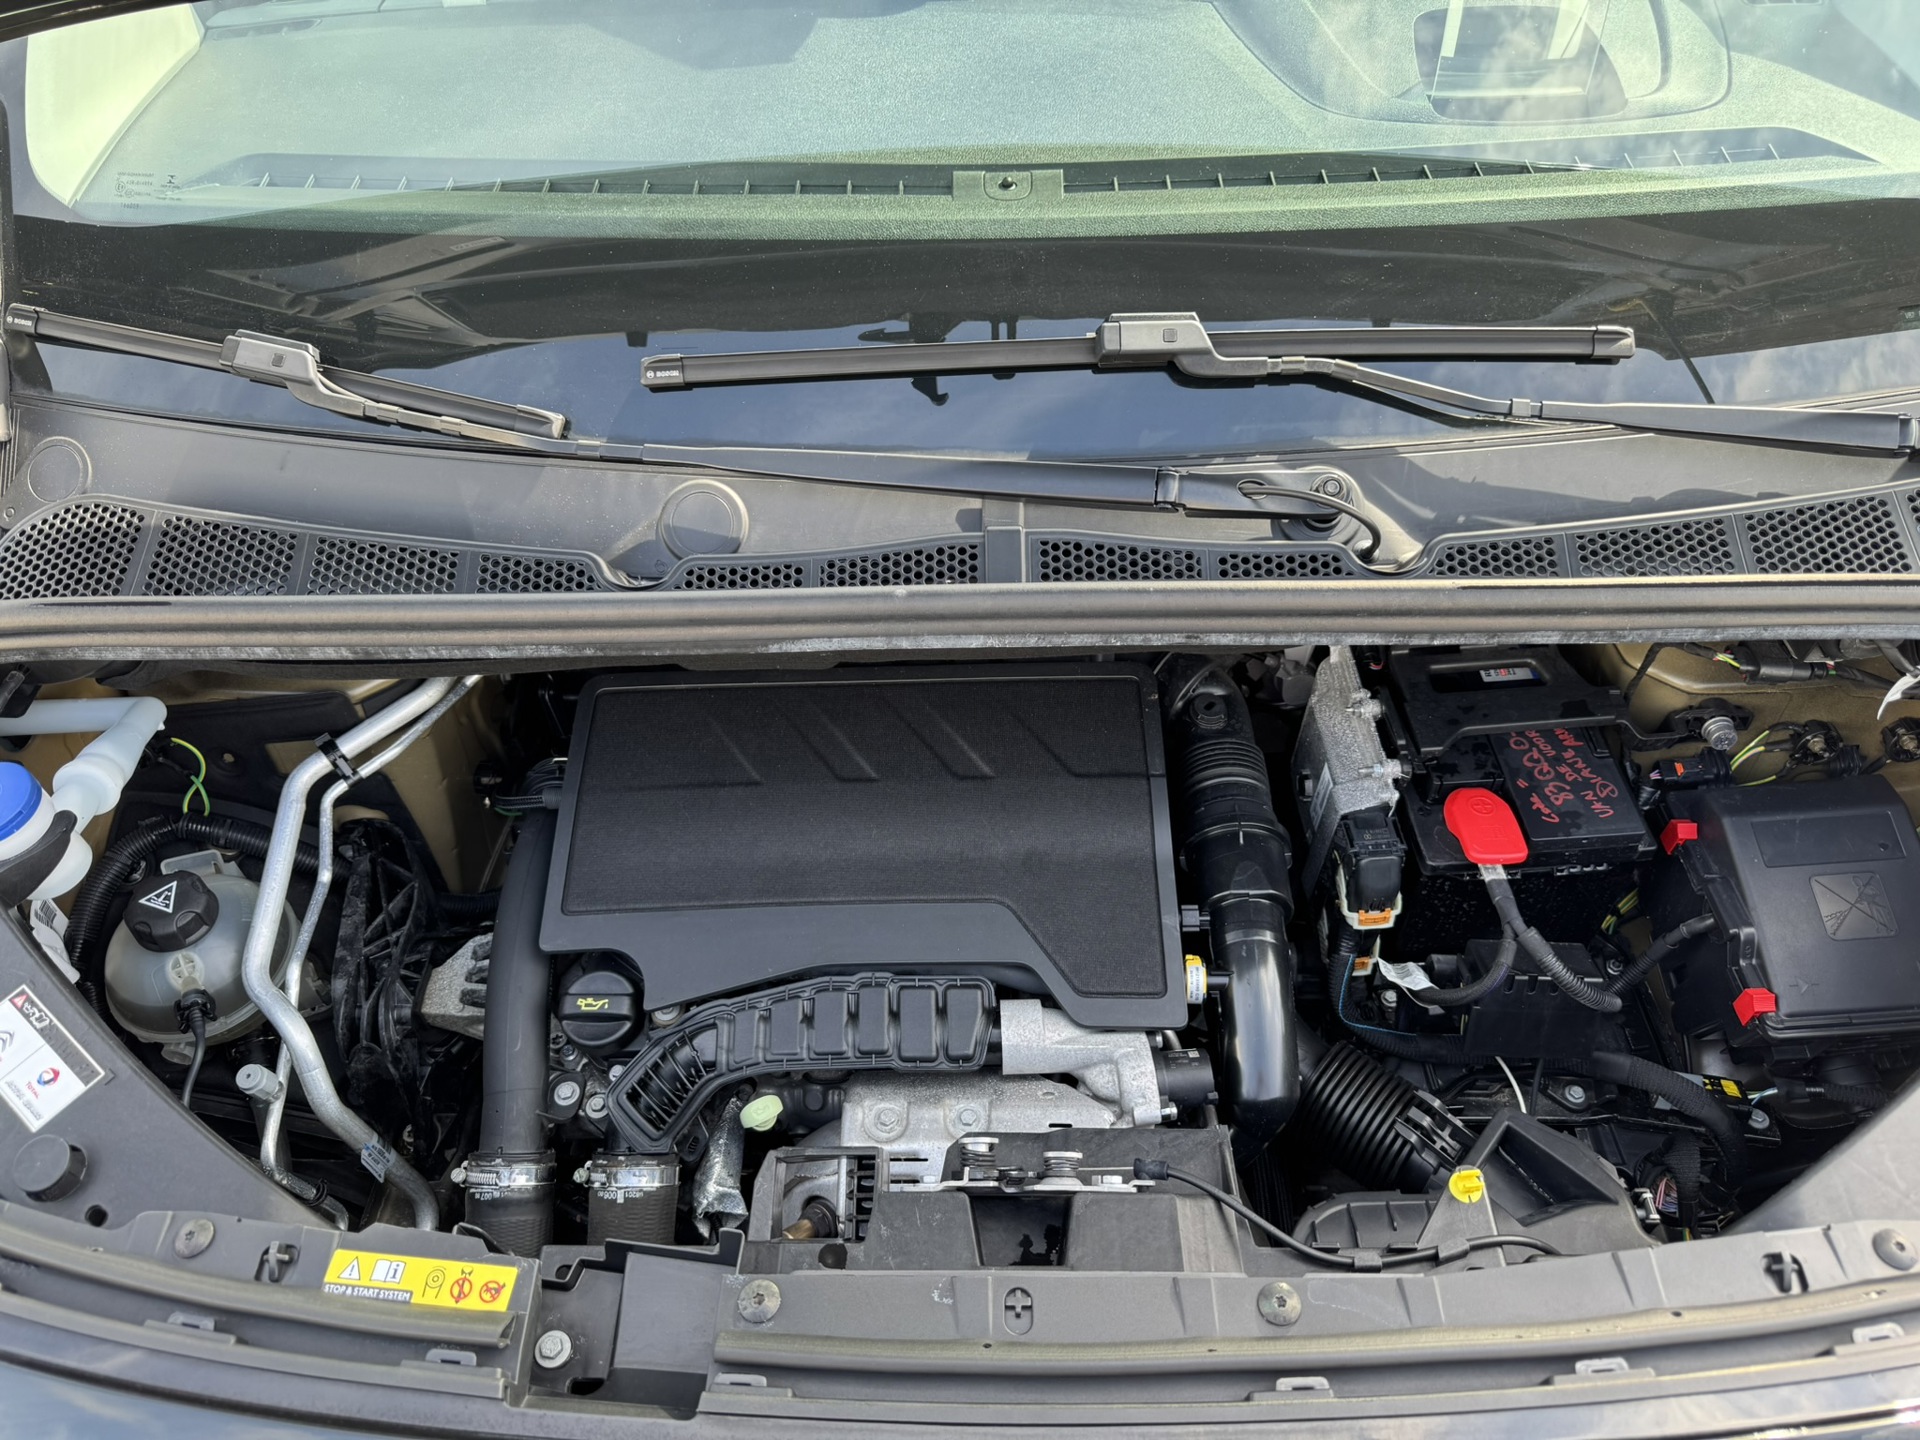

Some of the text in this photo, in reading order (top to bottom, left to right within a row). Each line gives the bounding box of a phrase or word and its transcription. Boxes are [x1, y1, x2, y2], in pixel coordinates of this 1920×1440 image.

[1556, 763, 1582, 782] DE
[1561, 749, 1618, 798] DIANE
[1580, 790, 1614, 818] VAN
[26, 1081, 39, 1099] TOTAL
[324, 1284, 411, 1301] STOP & START SYSTEM
